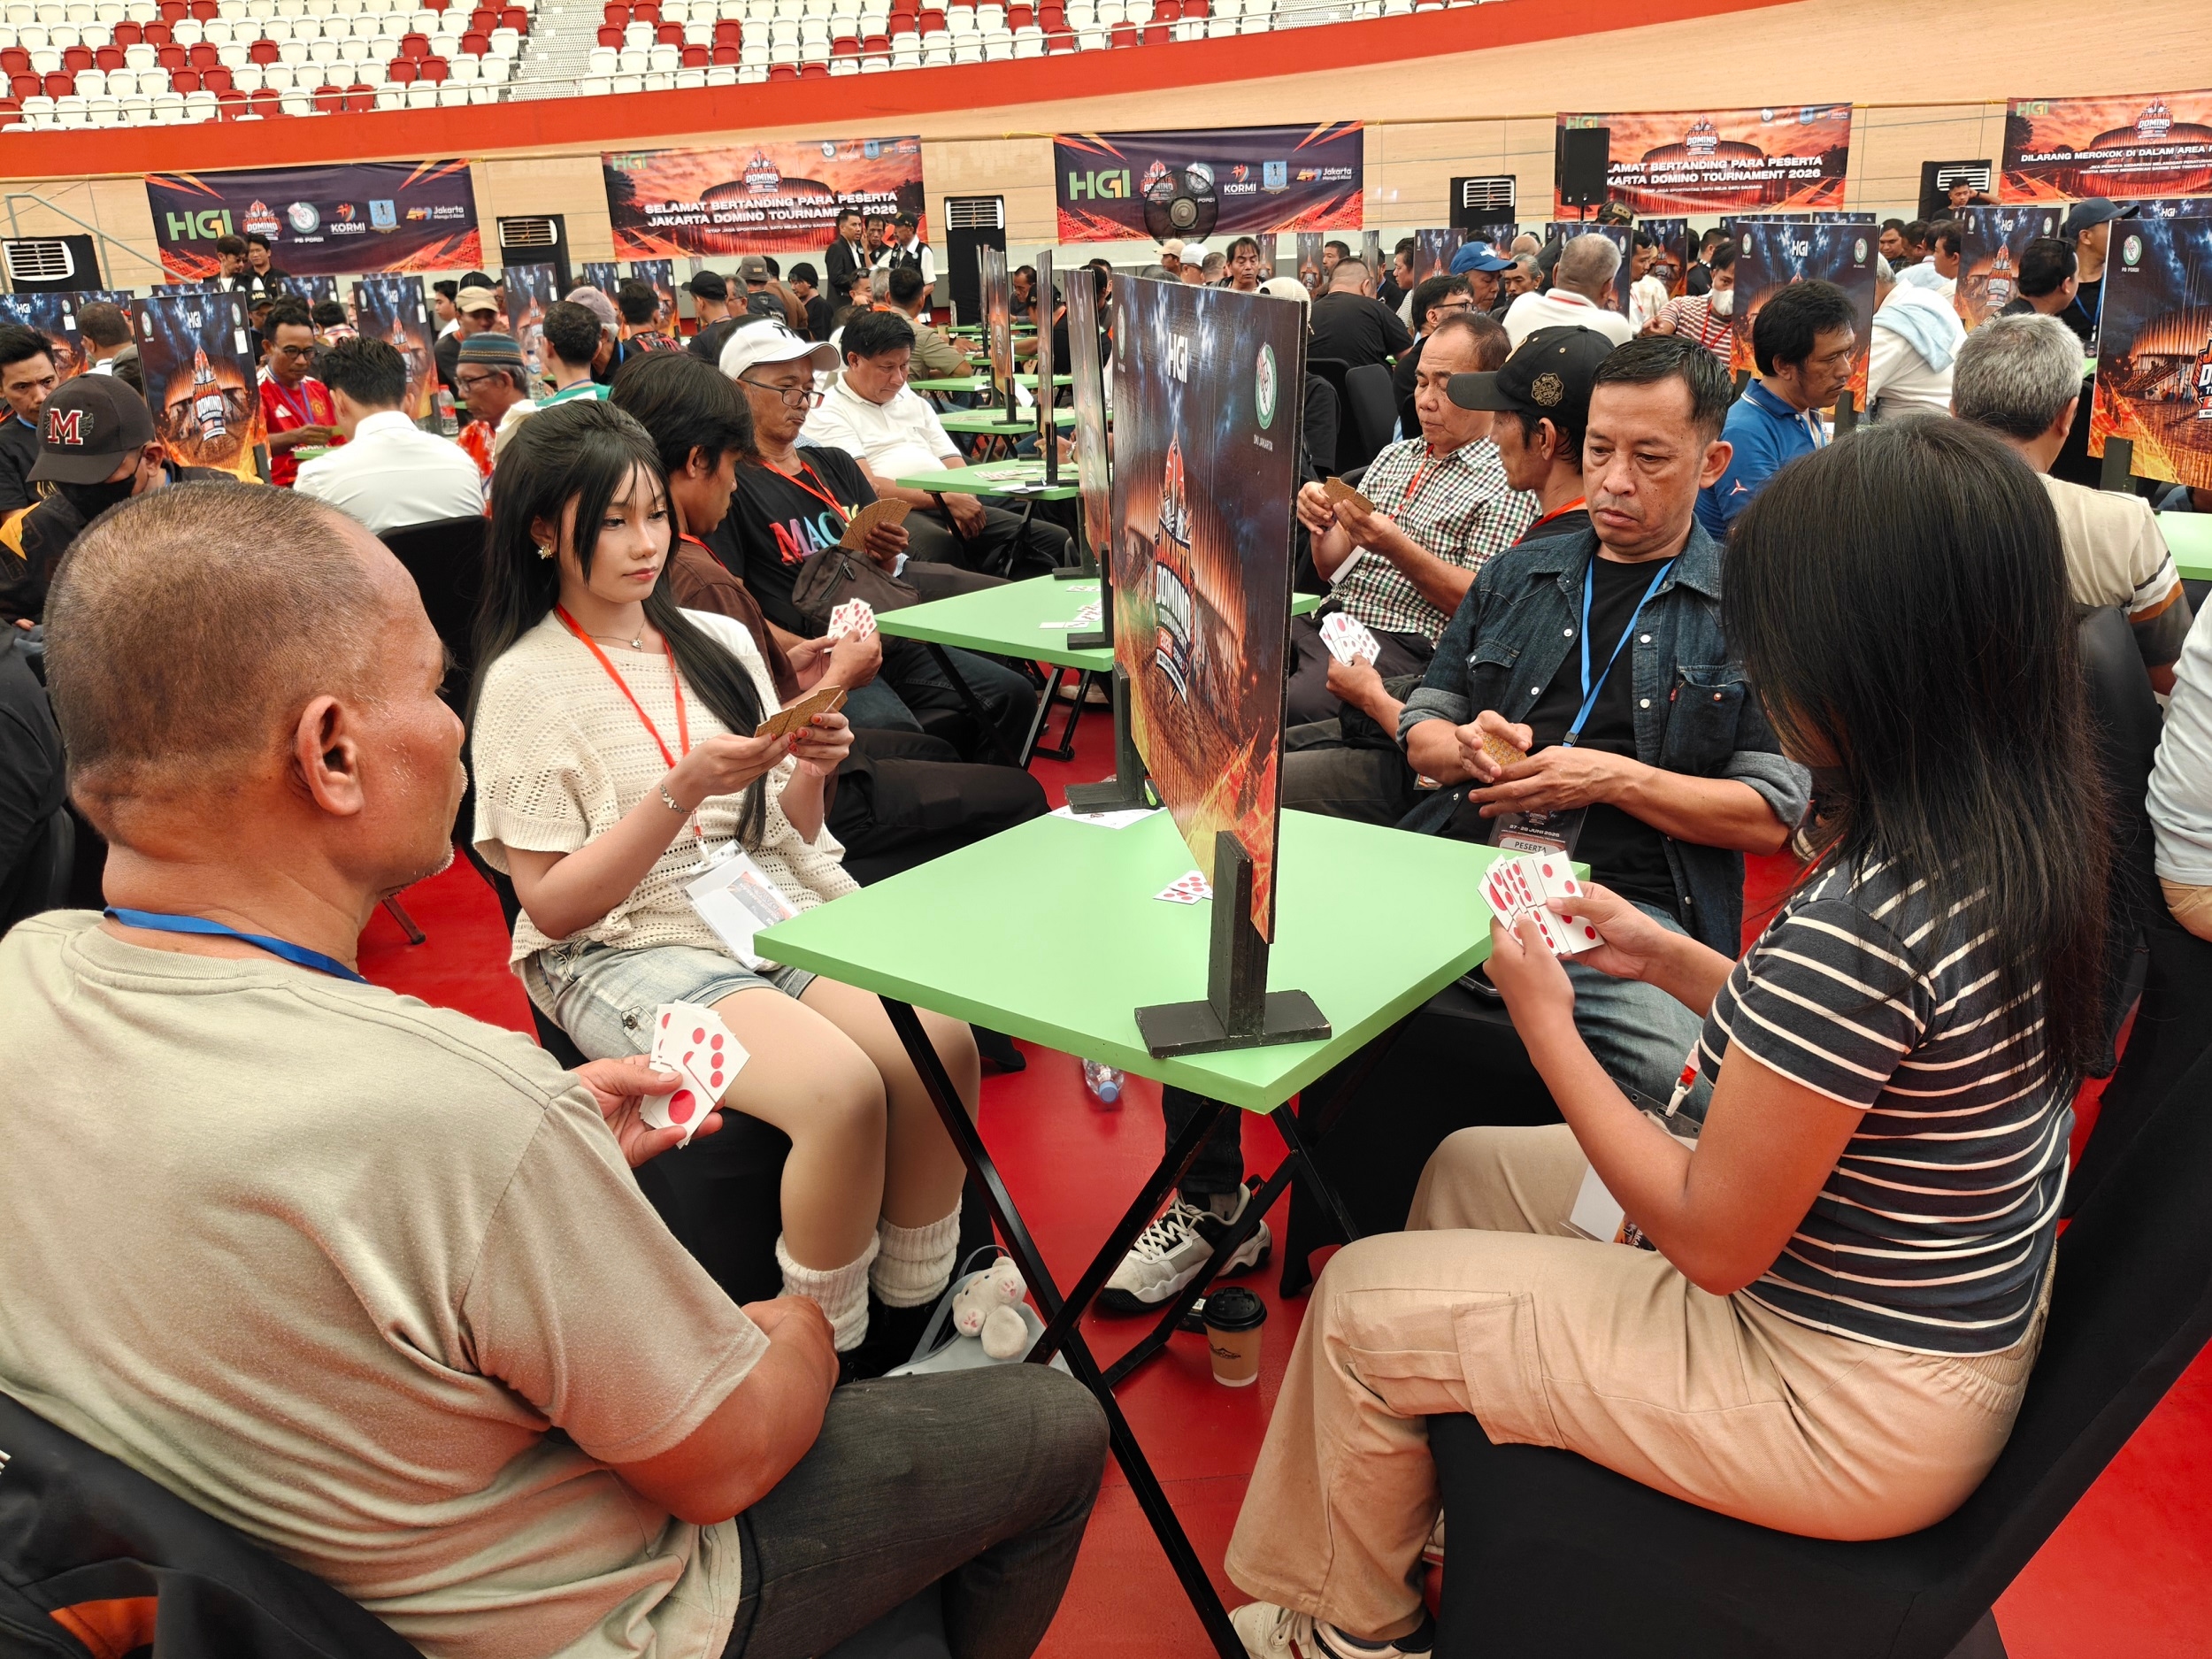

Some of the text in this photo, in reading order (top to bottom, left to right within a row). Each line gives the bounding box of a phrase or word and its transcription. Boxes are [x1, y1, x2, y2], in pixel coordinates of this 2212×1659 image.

[2138, 119, 2170, 128] DOMINO
[1686, 136, 1717, 146] DOMINO
[2021, 152, 2072, 163] DILARANG
[2074, 150, 2124, 159] MEROKOK
[2177, 145, 2205, 154] AREA
[1323, 166, 1352, 176] Jakarta
[1651, 161, 1727, 172] BERTANDING
[1731, 158, 1764, 168] PARA
[1768, 156, 1823, 166] PESERTA
[746, 173, 779, 184] DOMINO
[1069, 169, 1131, 201] HGI
[1607, 168, 1821, 186] KARTA DOMINO TOURNAMENT 2026
[1224, 184, 1256, 193] KORMI
[434, 205, 464, 214] Jakarta
[644, 191, 897, 214] SELAMAT BERTANDING PARA PESERTA
[648, 205, 897, 227] JAKARTA DOMINO TOURNAME 2026
[2162, 207, 2175, 218] HGI
[166, 209, 234, 241] HGI
[247, 223, 278, 232] DOMINO
[331, 223, 365, 232] KORMI
[2001, 219, 2014, 232] HGI
[1792, 241, 1809, 257] HGI
[16, 303, 31, 313] HGI
[188, 311, 202, 329] HGI
[1168, 333, 1187, 383] HGI
[196, 395, 223, 419] DOMINO
[48, 408, 83, 445] M
[1156, 524, 1190, 590] JAKARTA
[1156, 565, 1191, 642] DOMINO
[1159, 608, 1186, 653] TOURNAMENT
[1161, 630, 1171, 654] 2026
[1515, 841, 1547, 853] PESERTA
[757, 890, 780, 911] DAY
